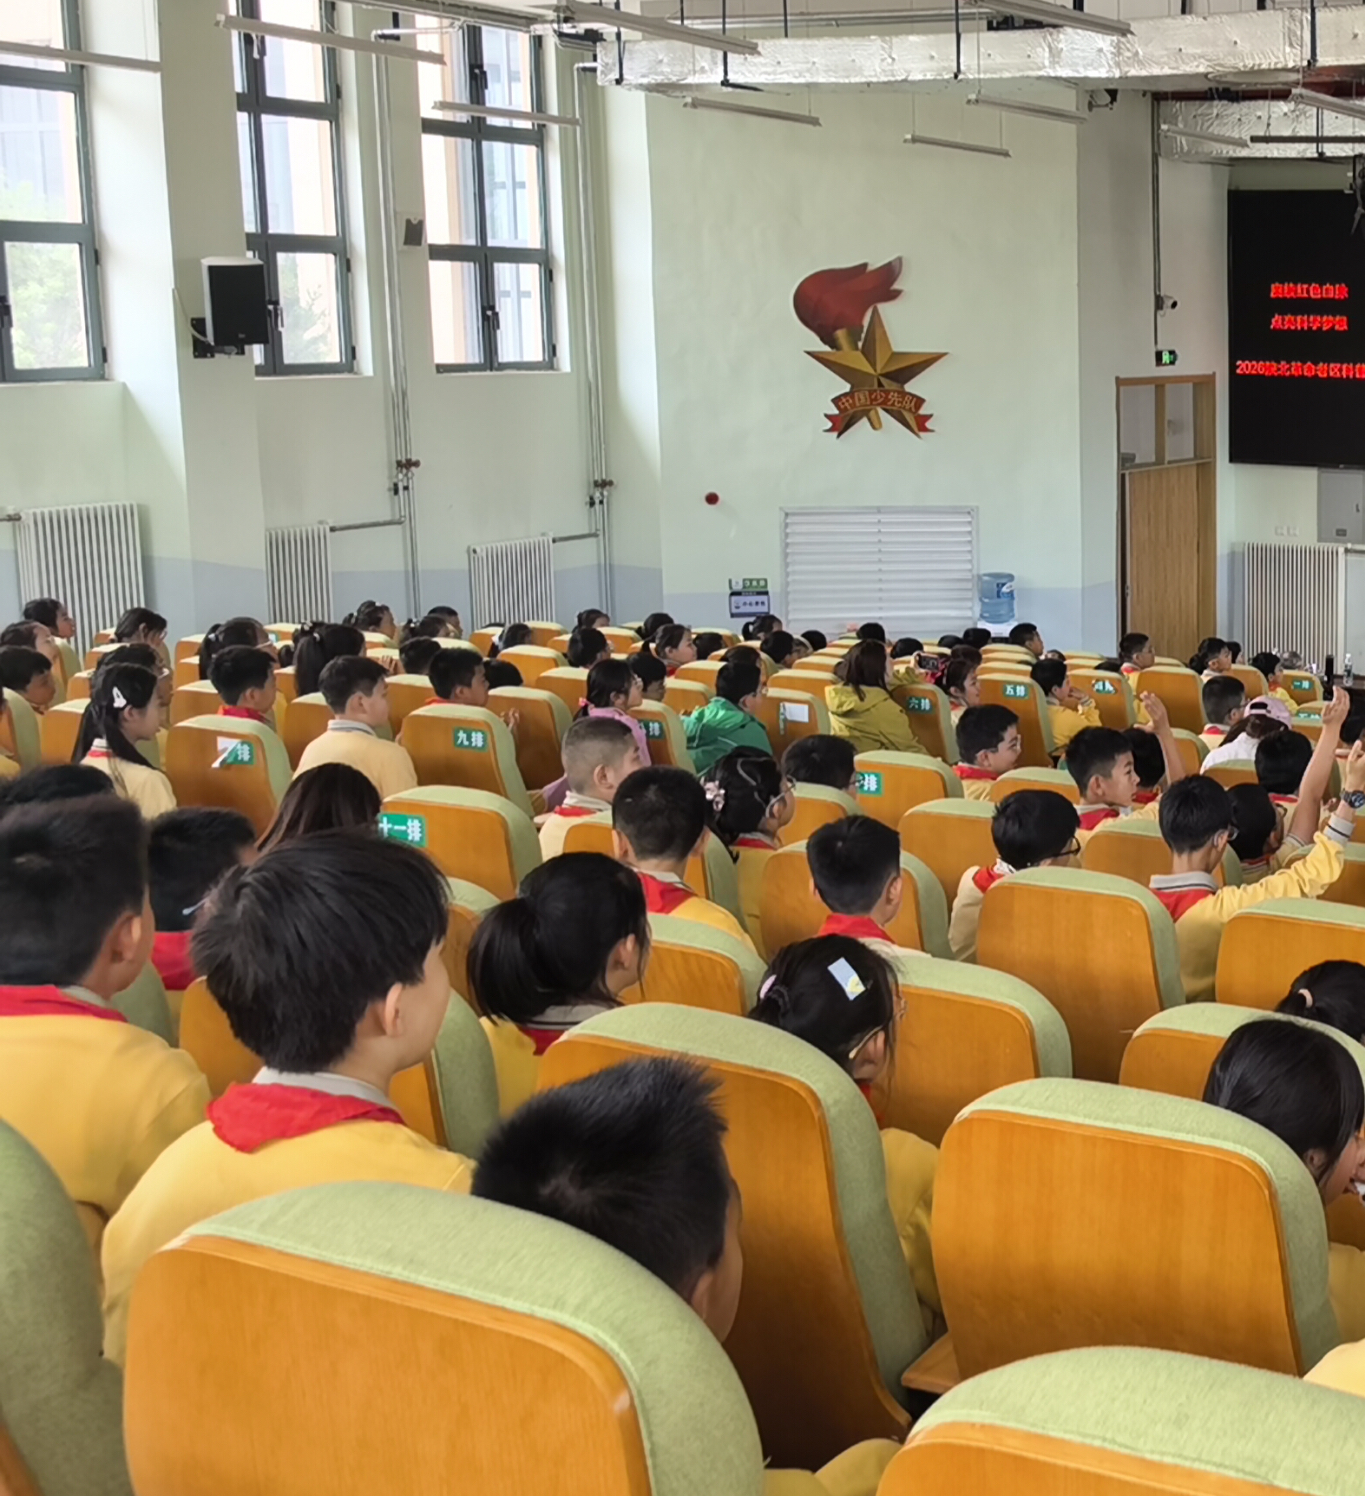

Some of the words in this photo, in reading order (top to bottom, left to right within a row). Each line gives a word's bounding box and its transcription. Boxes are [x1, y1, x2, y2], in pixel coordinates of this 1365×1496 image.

[1270, 313, 1348, 331] 点亮科学梦想
[837, 389, 918, 413] 中国少先队
[456, 729, 484, 748] 九排
[378, 816, 422, 842] 十一排
